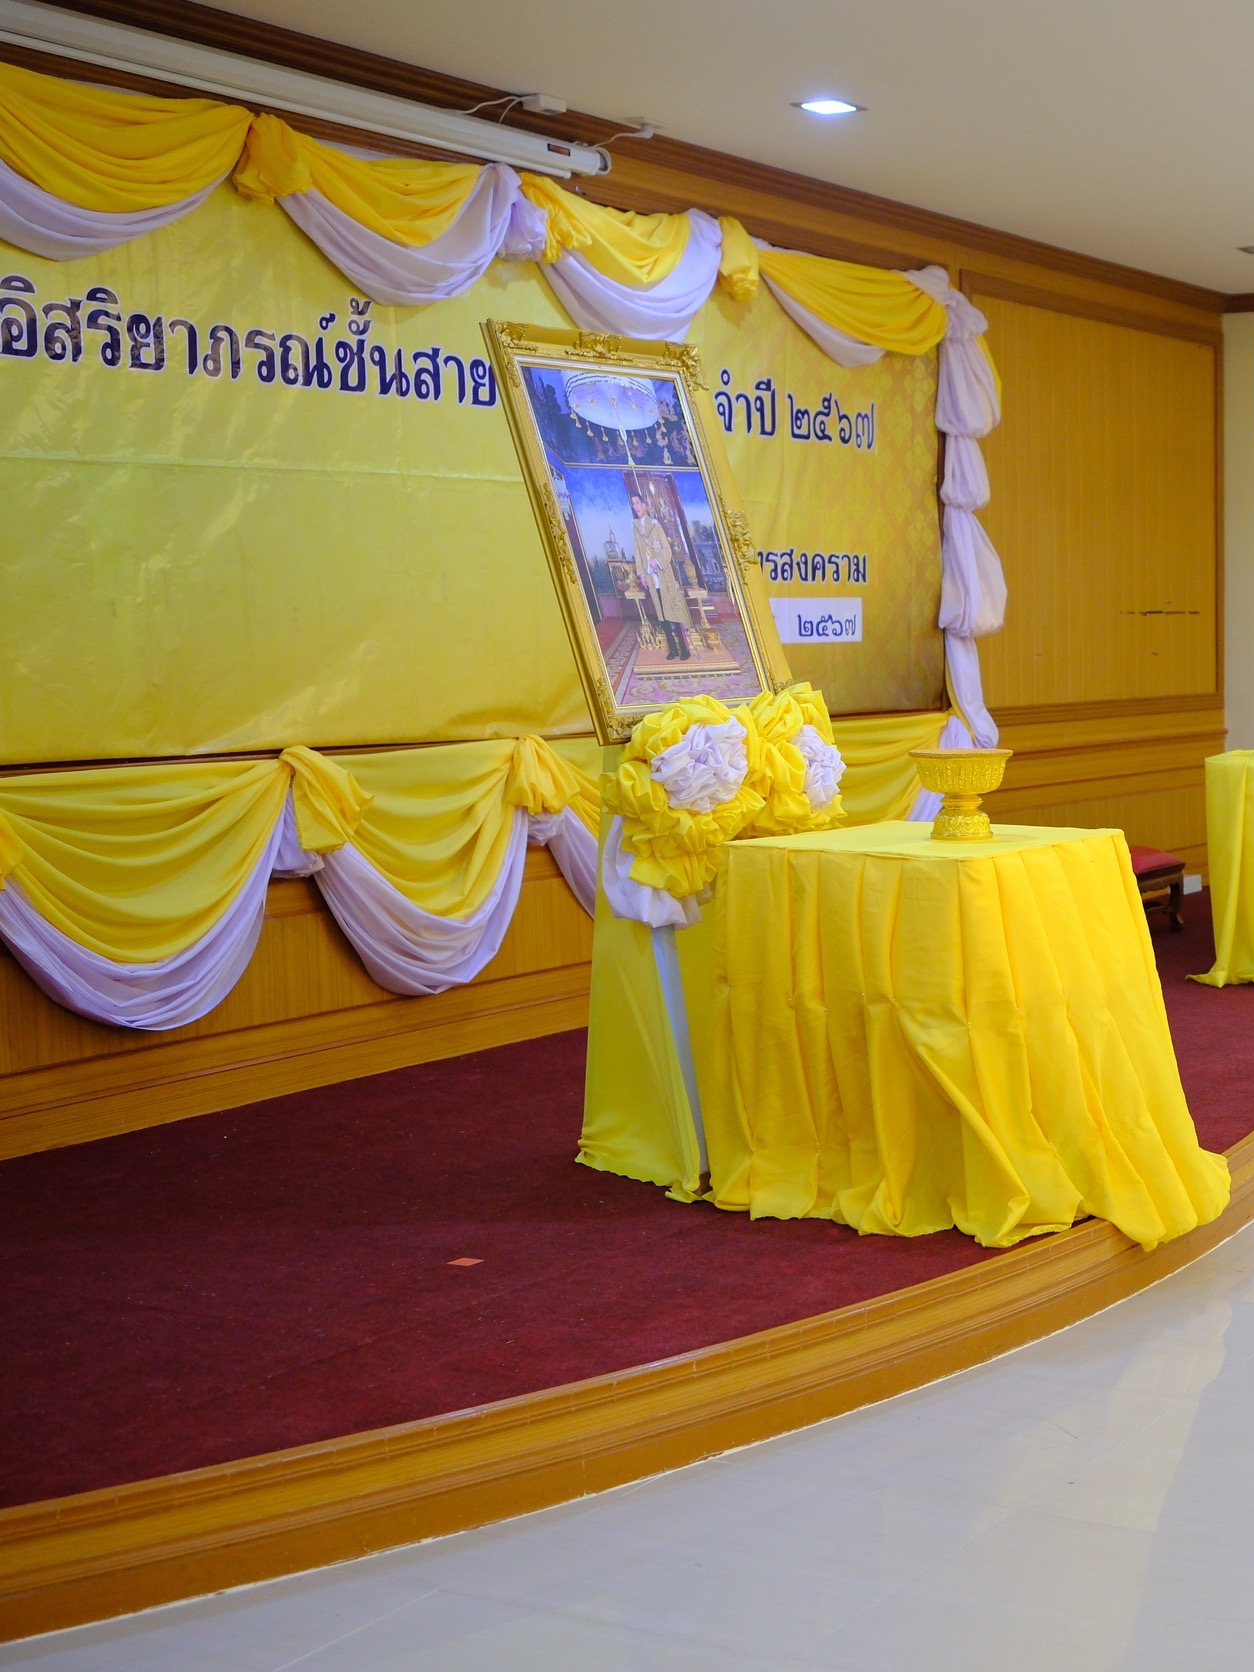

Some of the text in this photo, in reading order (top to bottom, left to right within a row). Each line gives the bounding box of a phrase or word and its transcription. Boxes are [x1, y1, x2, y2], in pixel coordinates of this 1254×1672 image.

[714, 368, 776, 437] จำปี
[787, 392, 875, 450] ๒๕๖๗
[797, 613, 856, 637] ๒๕๖๗
